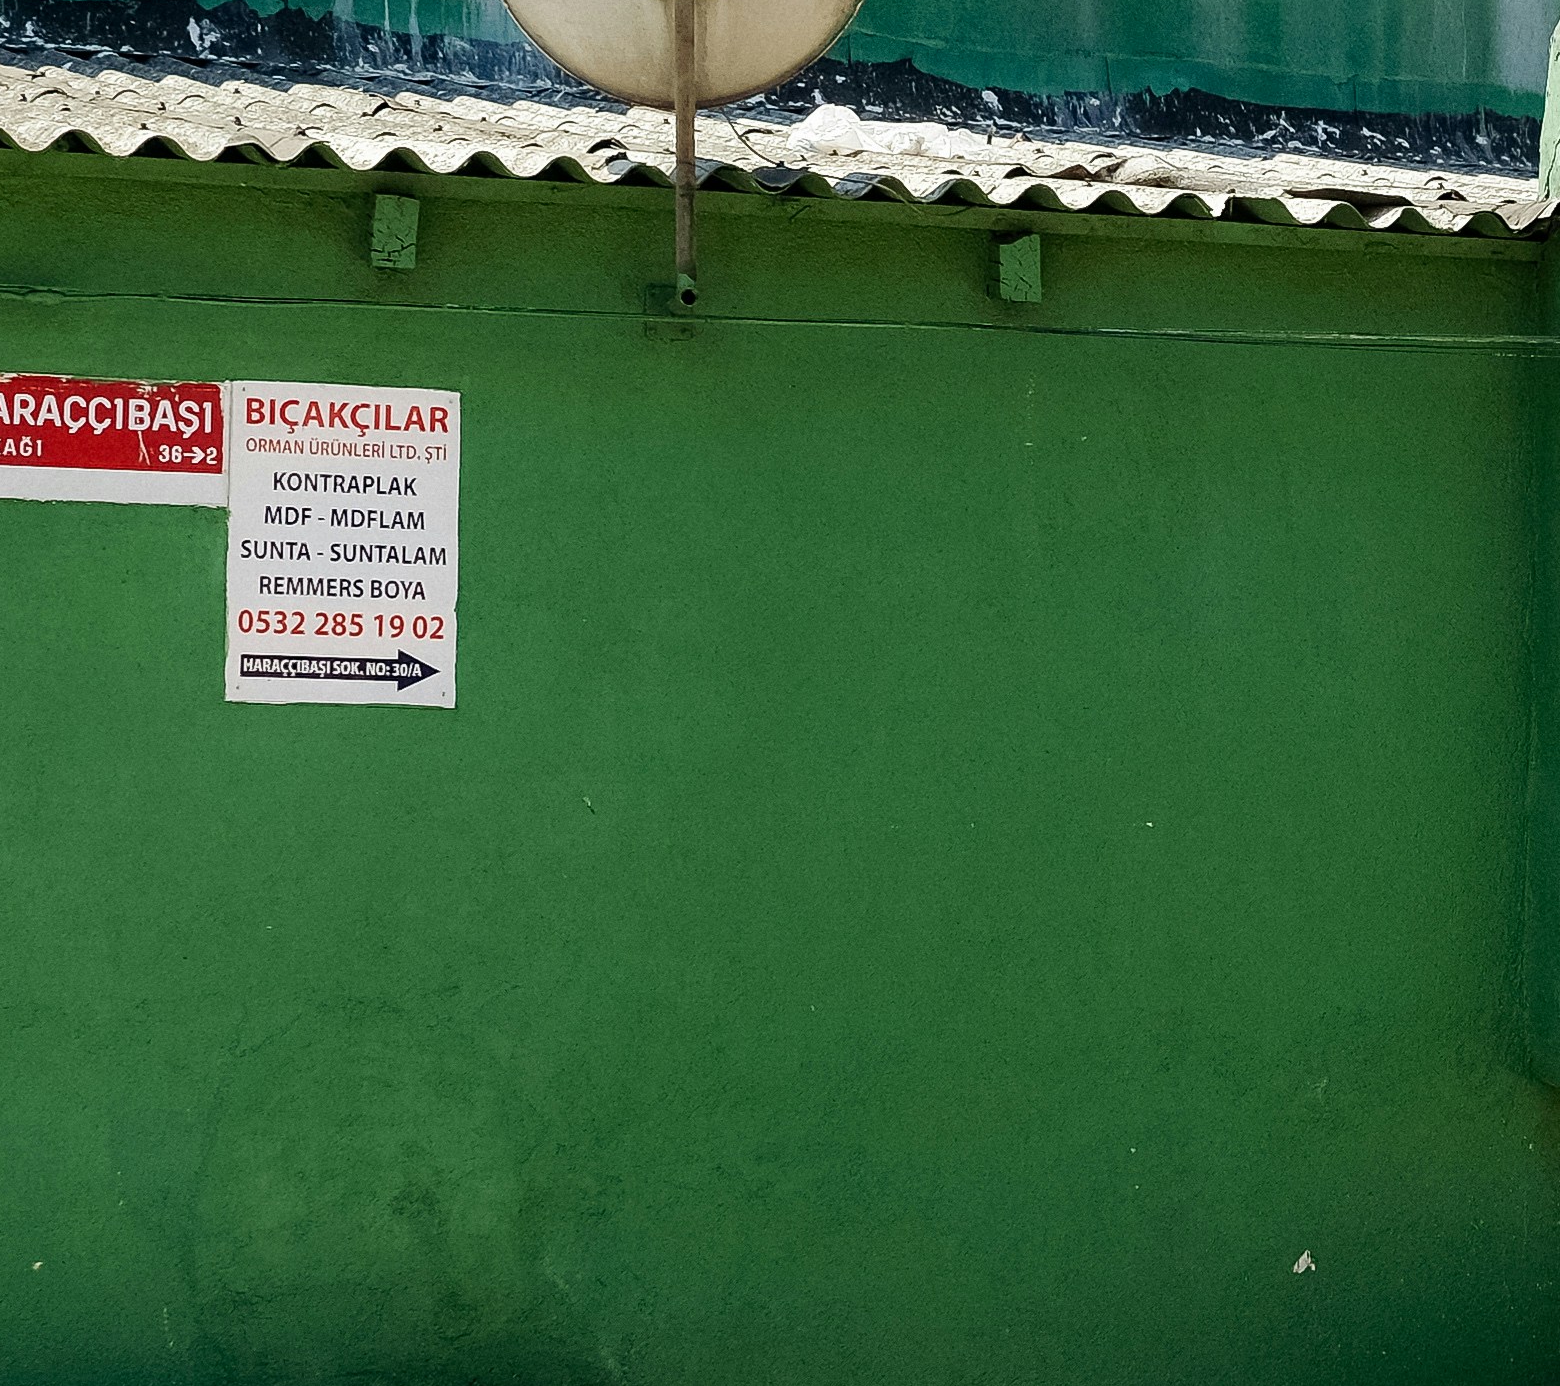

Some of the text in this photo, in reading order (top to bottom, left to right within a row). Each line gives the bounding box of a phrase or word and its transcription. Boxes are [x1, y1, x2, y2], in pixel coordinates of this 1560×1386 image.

[246, 397, 449, 438] BIÇAKÇILAR
[246, 437, 447, 464] ORMAN ÜRÜNLERİ LTD. ŞTİ
[273, 472, 418, 497] KONTRAPLAK
[264, 506, 312, 526] MDF
[330, 509, 425, 530] MDFLAM
[241, 539, 311, 562] SUNTA
[329, 543, 447, 566] SUNTALAM
[259, 576, 426, 601] REMMERS BOYA
[238, 609, 444, 640] 0532 285 19 02
[243, 657, 422, 678] HARAÇÇIBAŞI SOK. NO: 30/A
